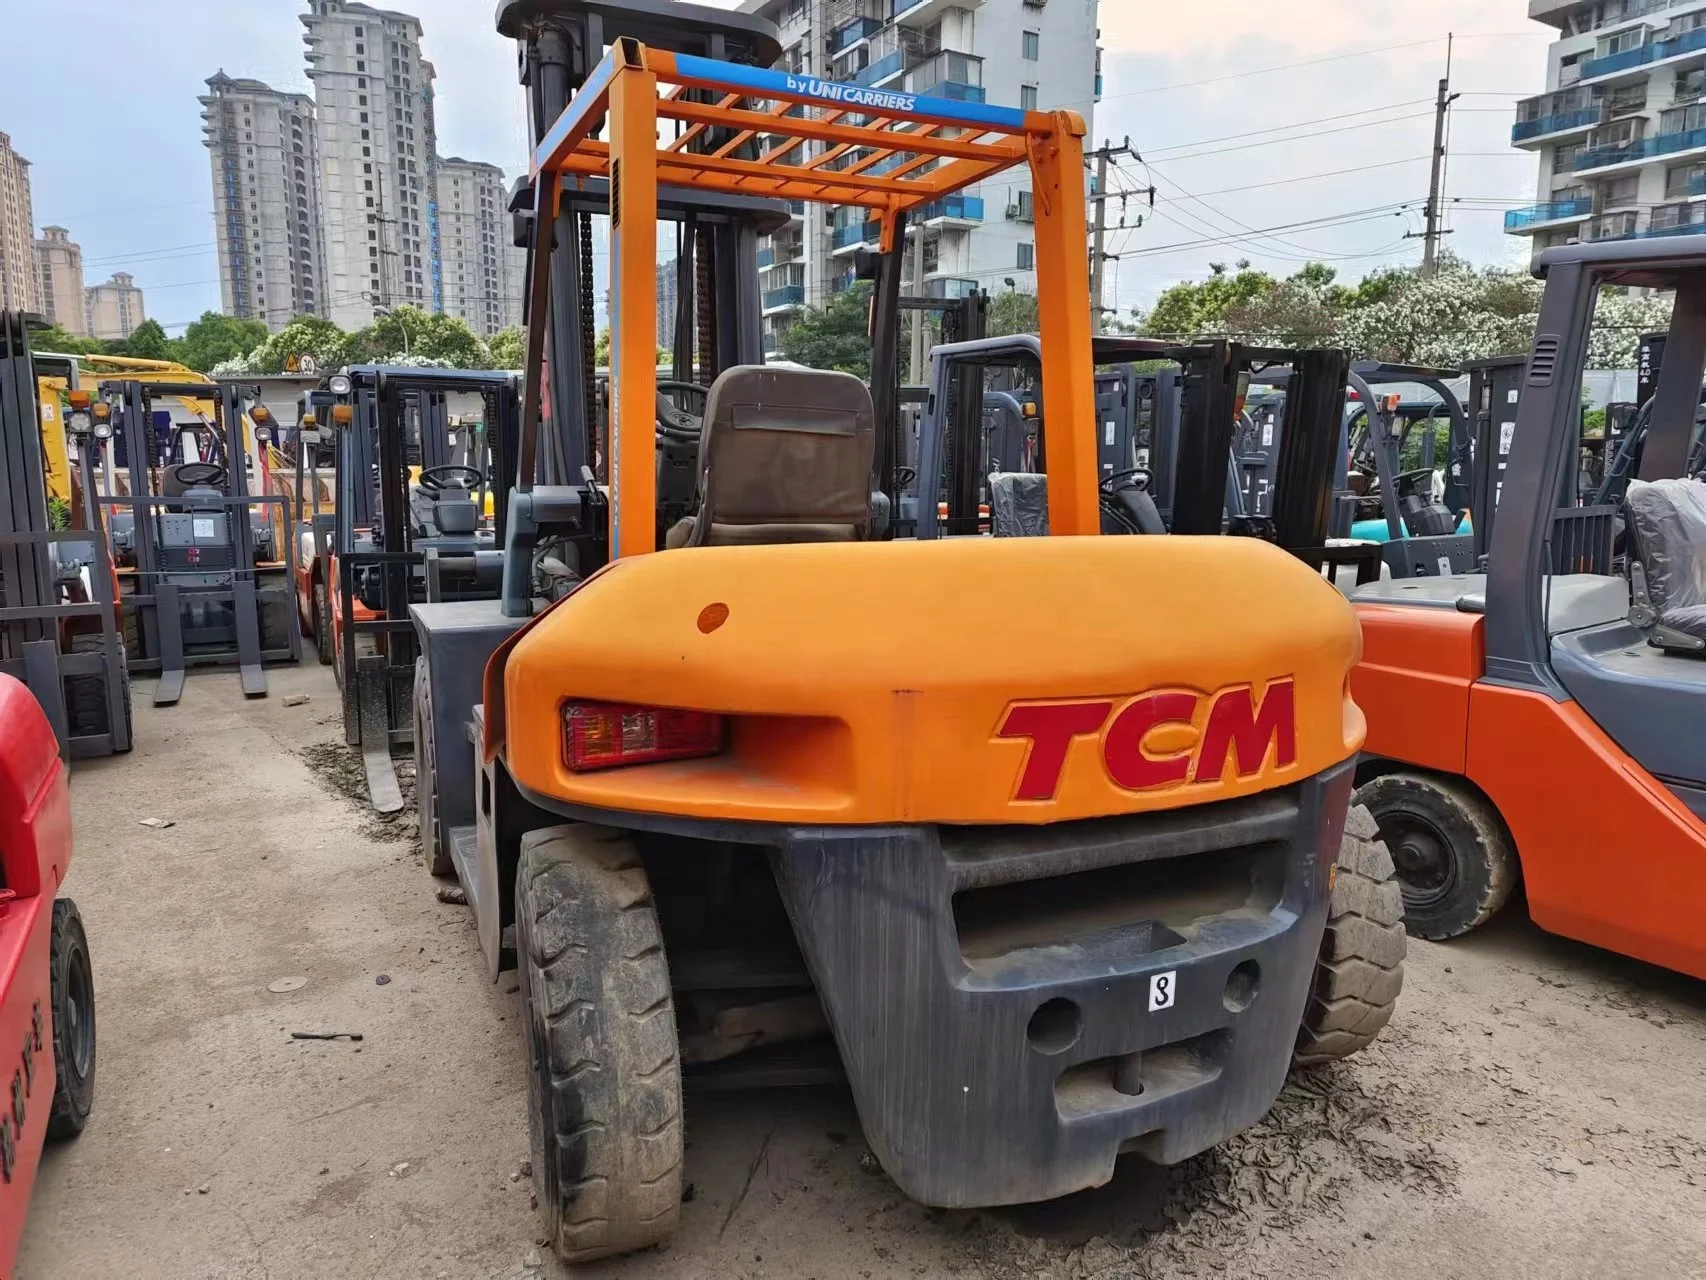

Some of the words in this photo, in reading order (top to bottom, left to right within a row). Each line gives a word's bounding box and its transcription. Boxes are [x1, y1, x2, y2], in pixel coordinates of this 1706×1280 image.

[786, 76, 806, 93] by
[808, 80, 917, 111] UNICARRIERS
[996, 678, 1297, 802] TCM
